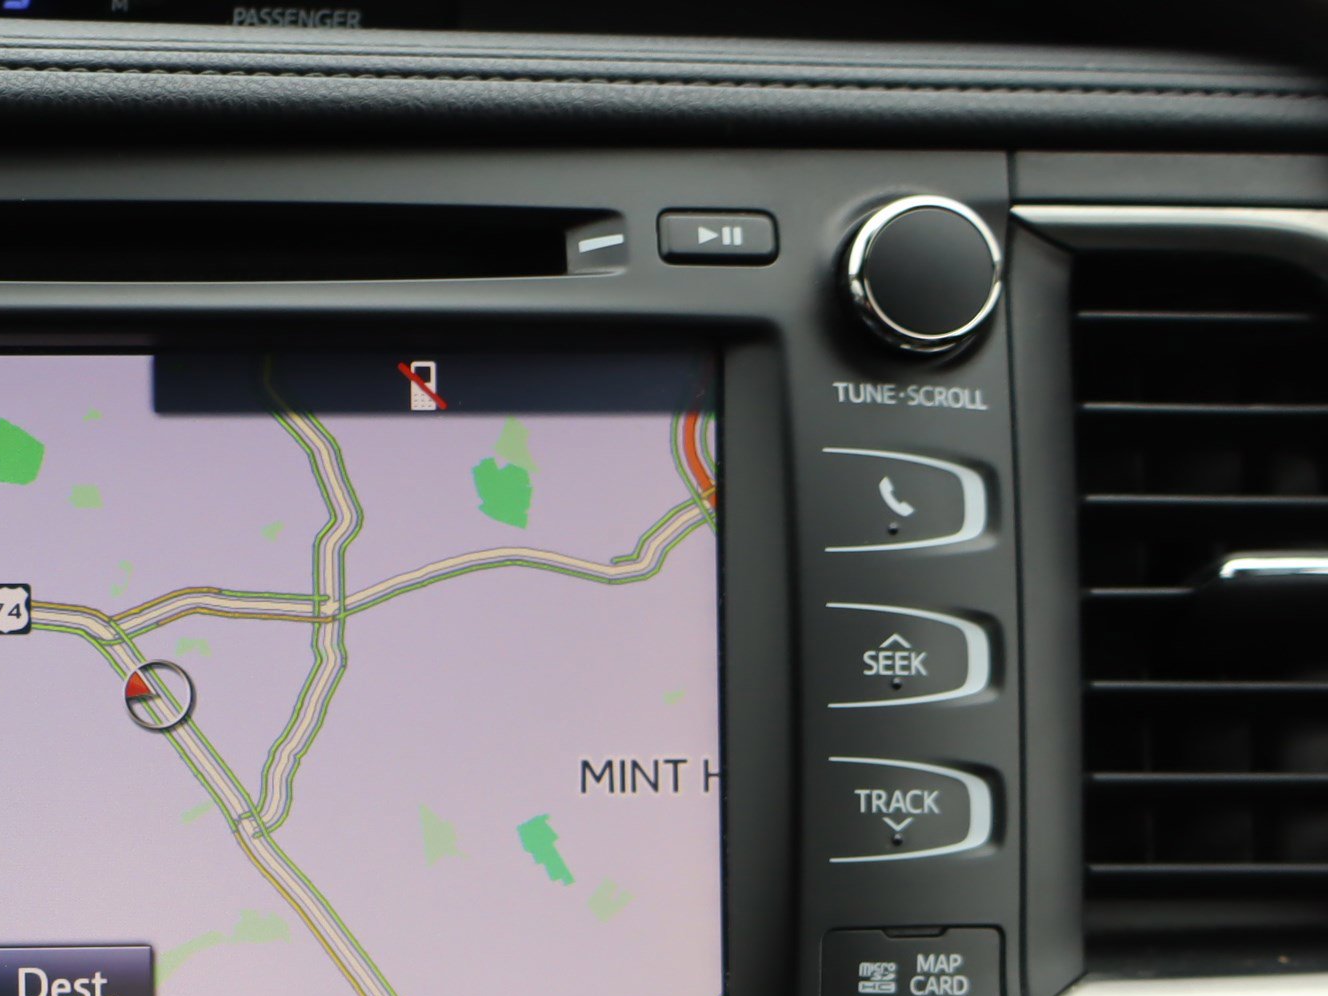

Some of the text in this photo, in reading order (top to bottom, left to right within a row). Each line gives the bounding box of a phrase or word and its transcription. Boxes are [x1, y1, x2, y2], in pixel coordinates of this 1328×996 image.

[233, 7, 362, 29] PASSENGER
[862, 650, 928, 676] SEEK
[580, 759, 688, 794] MINT
[854, 789, 940, 814] TRACK
[916, 953, 963, 974] MAP
[909, 975, 971, 996] CARD
